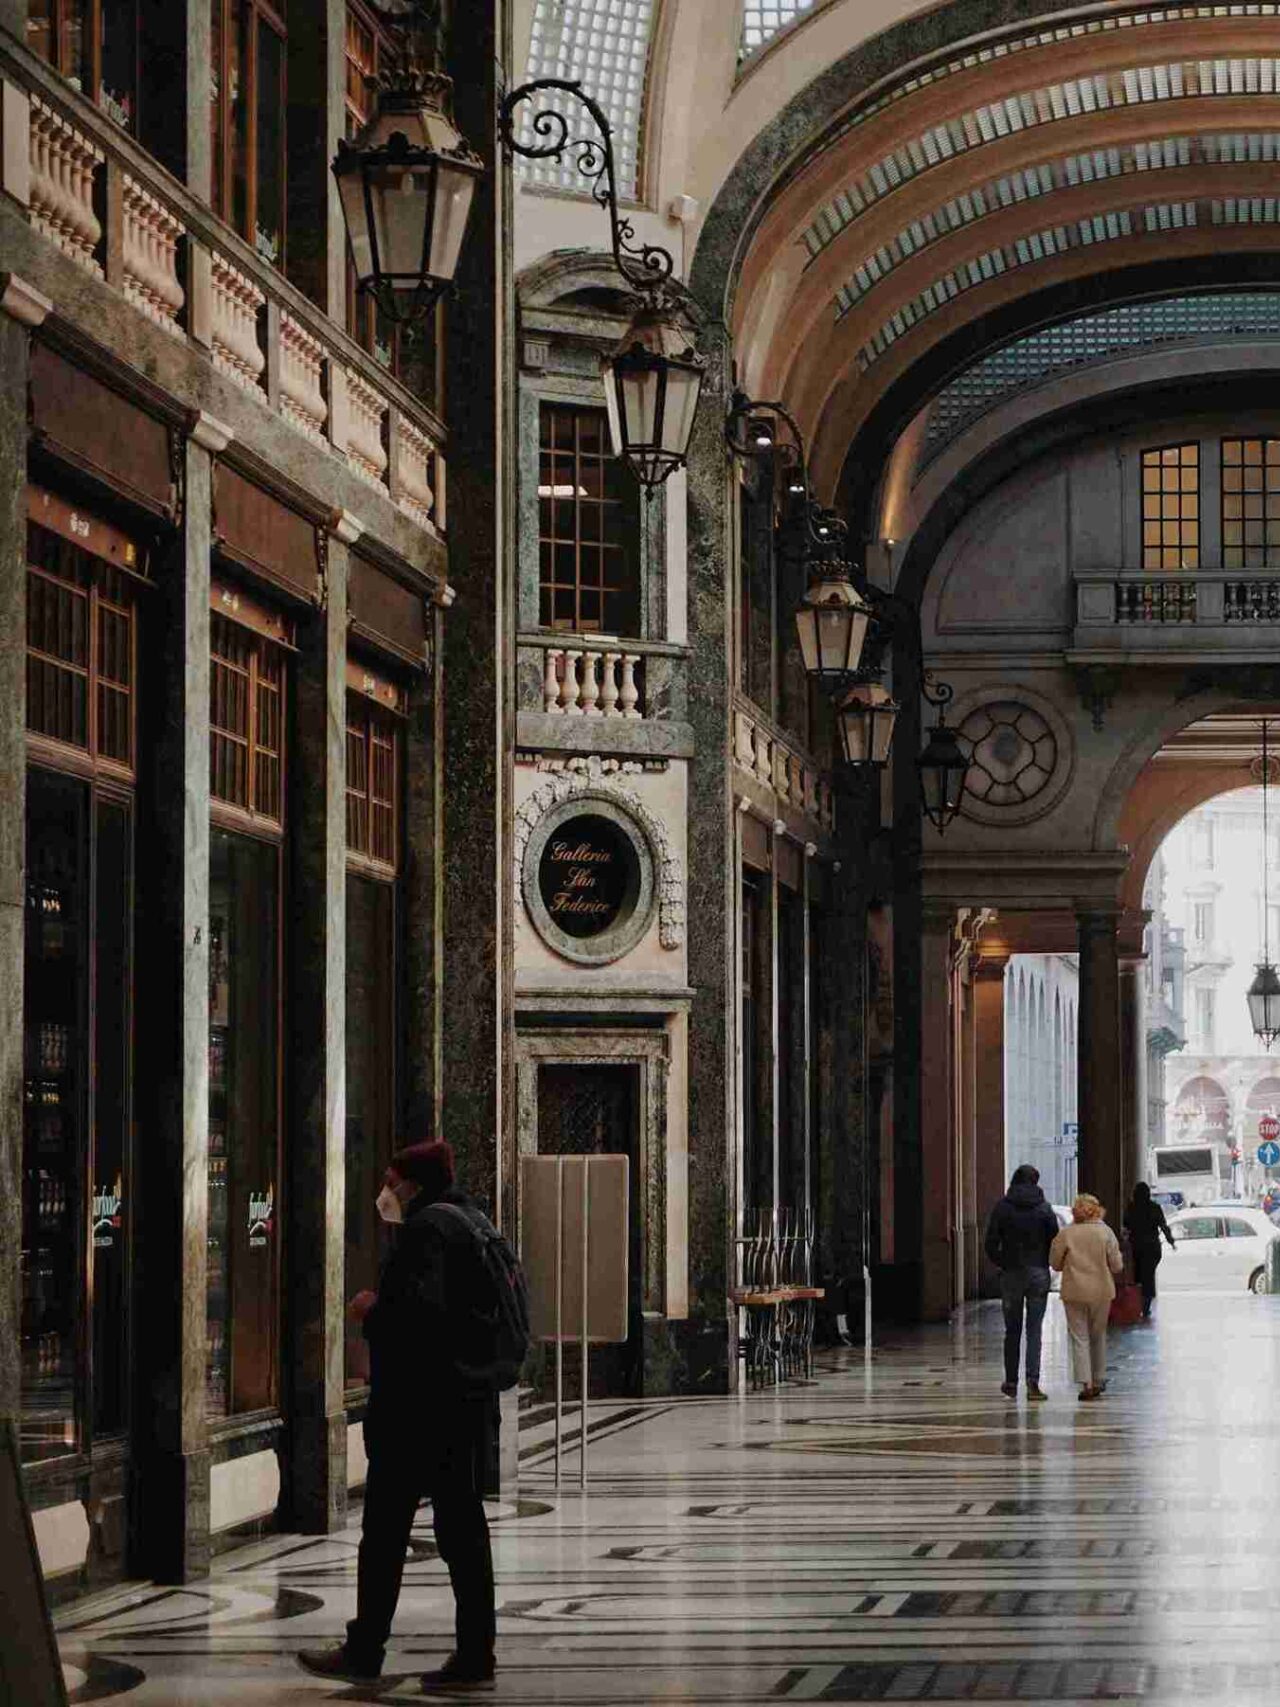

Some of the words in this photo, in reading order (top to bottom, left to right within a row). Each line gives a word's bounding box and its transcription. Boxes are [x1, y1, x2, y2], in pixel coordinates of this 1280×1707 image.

[551, 841, 611, 862] Galleria
[563, 865, 596, 888] San
[550, 892, 609, 912] Federico
[1260, 1123, 1280, 1134] STOP
